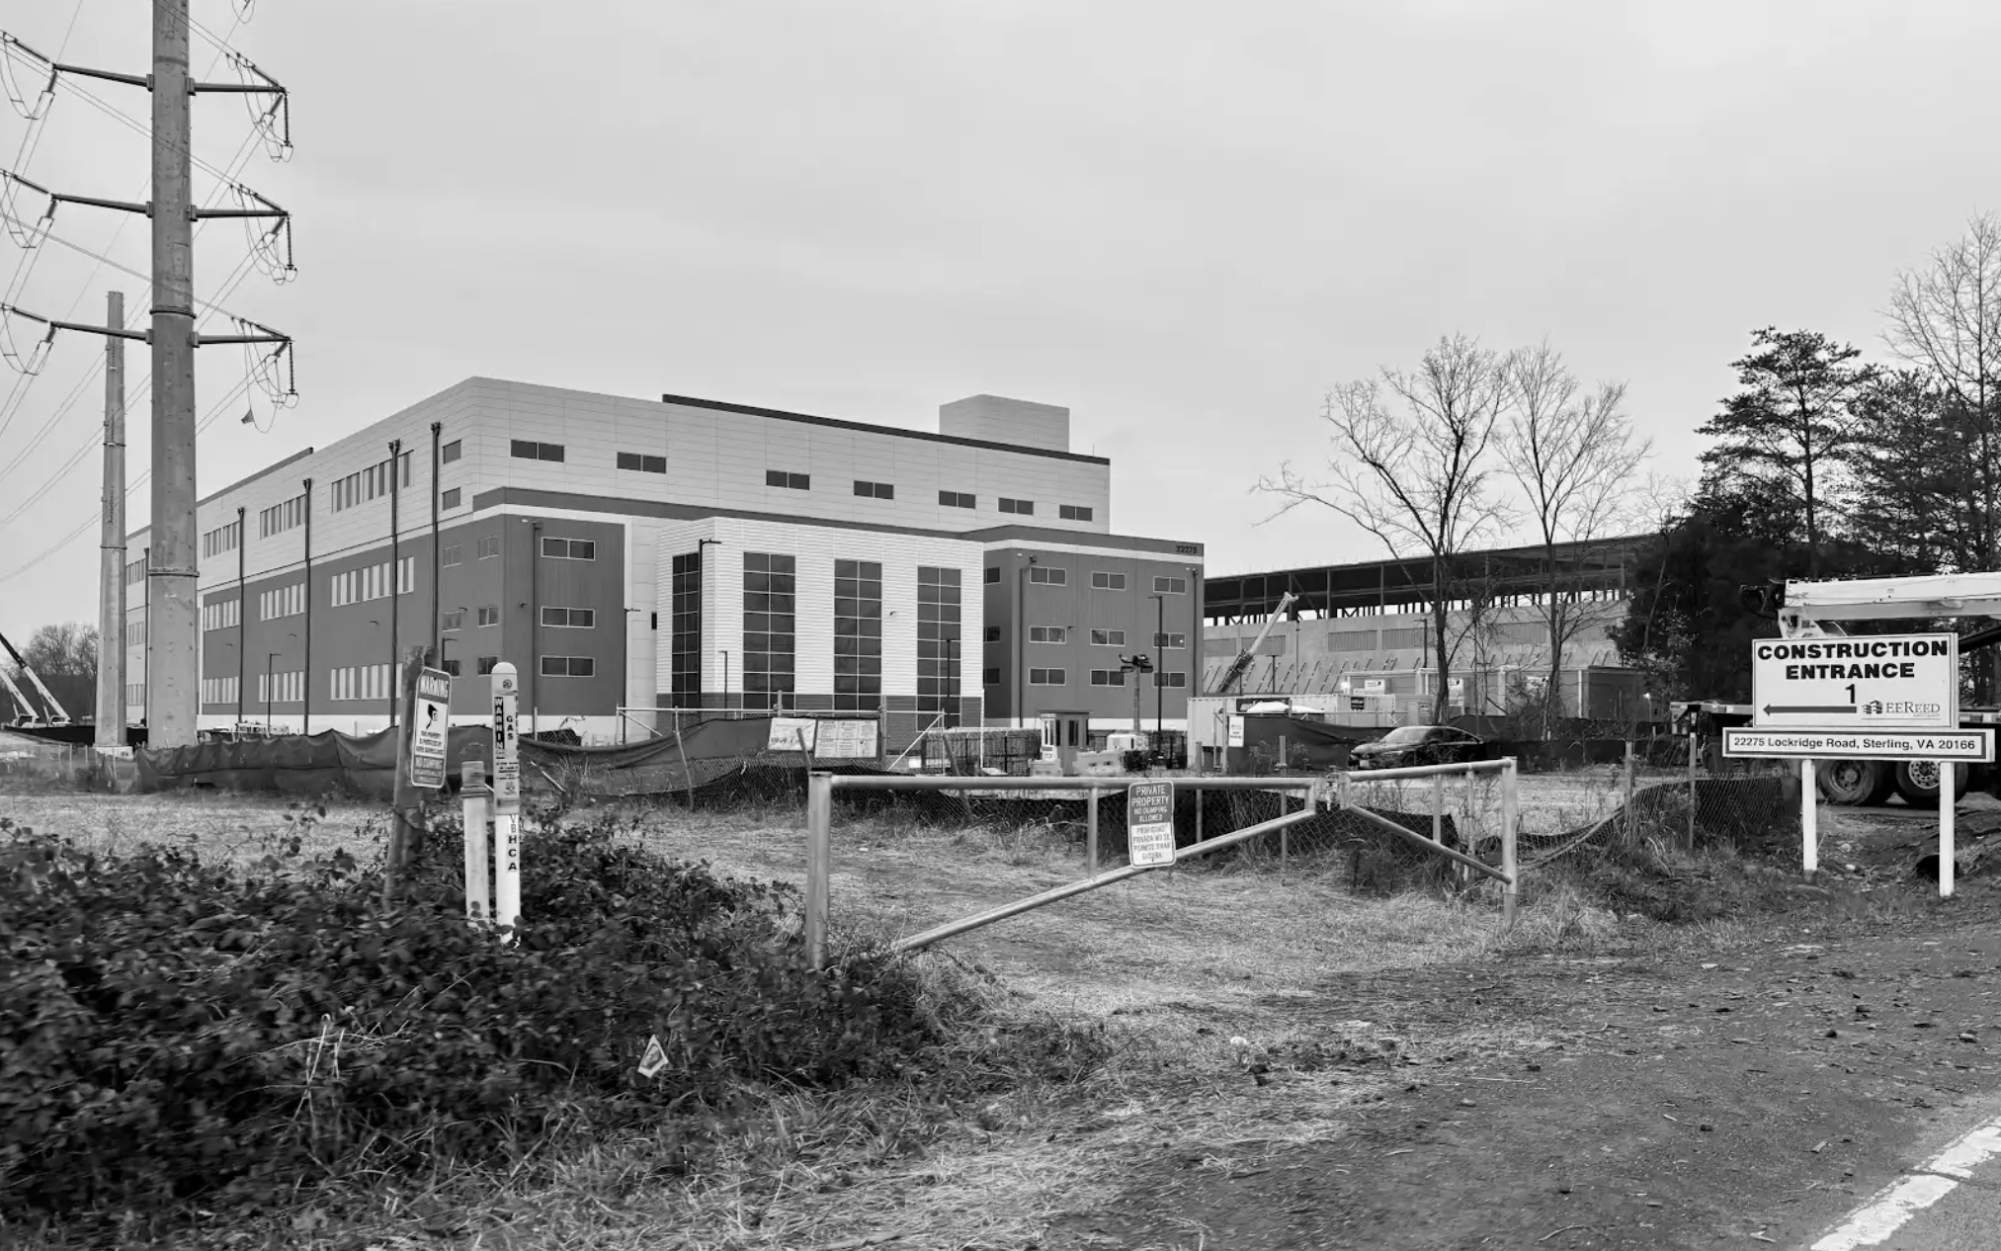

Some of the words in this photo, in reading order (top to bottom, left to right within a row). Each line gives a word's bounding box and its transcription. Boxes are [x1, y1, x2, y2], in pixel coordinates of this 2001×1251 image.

[1758, 640, 1948, 660] CONSTRUCTION
[1786, 663, 1915, 680] ENTRANCE
[1845, 684, 1856, 704] 1
[1734, 737, 1765, 747] 22275
[1768, 737, 1823, 750] Lockridge
[1827, 738, 1860, 750] Road,
[1863, 739, 1913, 752] Sterling,
[1917, 740, 1935, 750] VA
[1939, 740, 1975, 751] 20166
[1136, 785, 1165, 795] PRIVATE
[1132, 796, 1169, 806] PROPERTY
